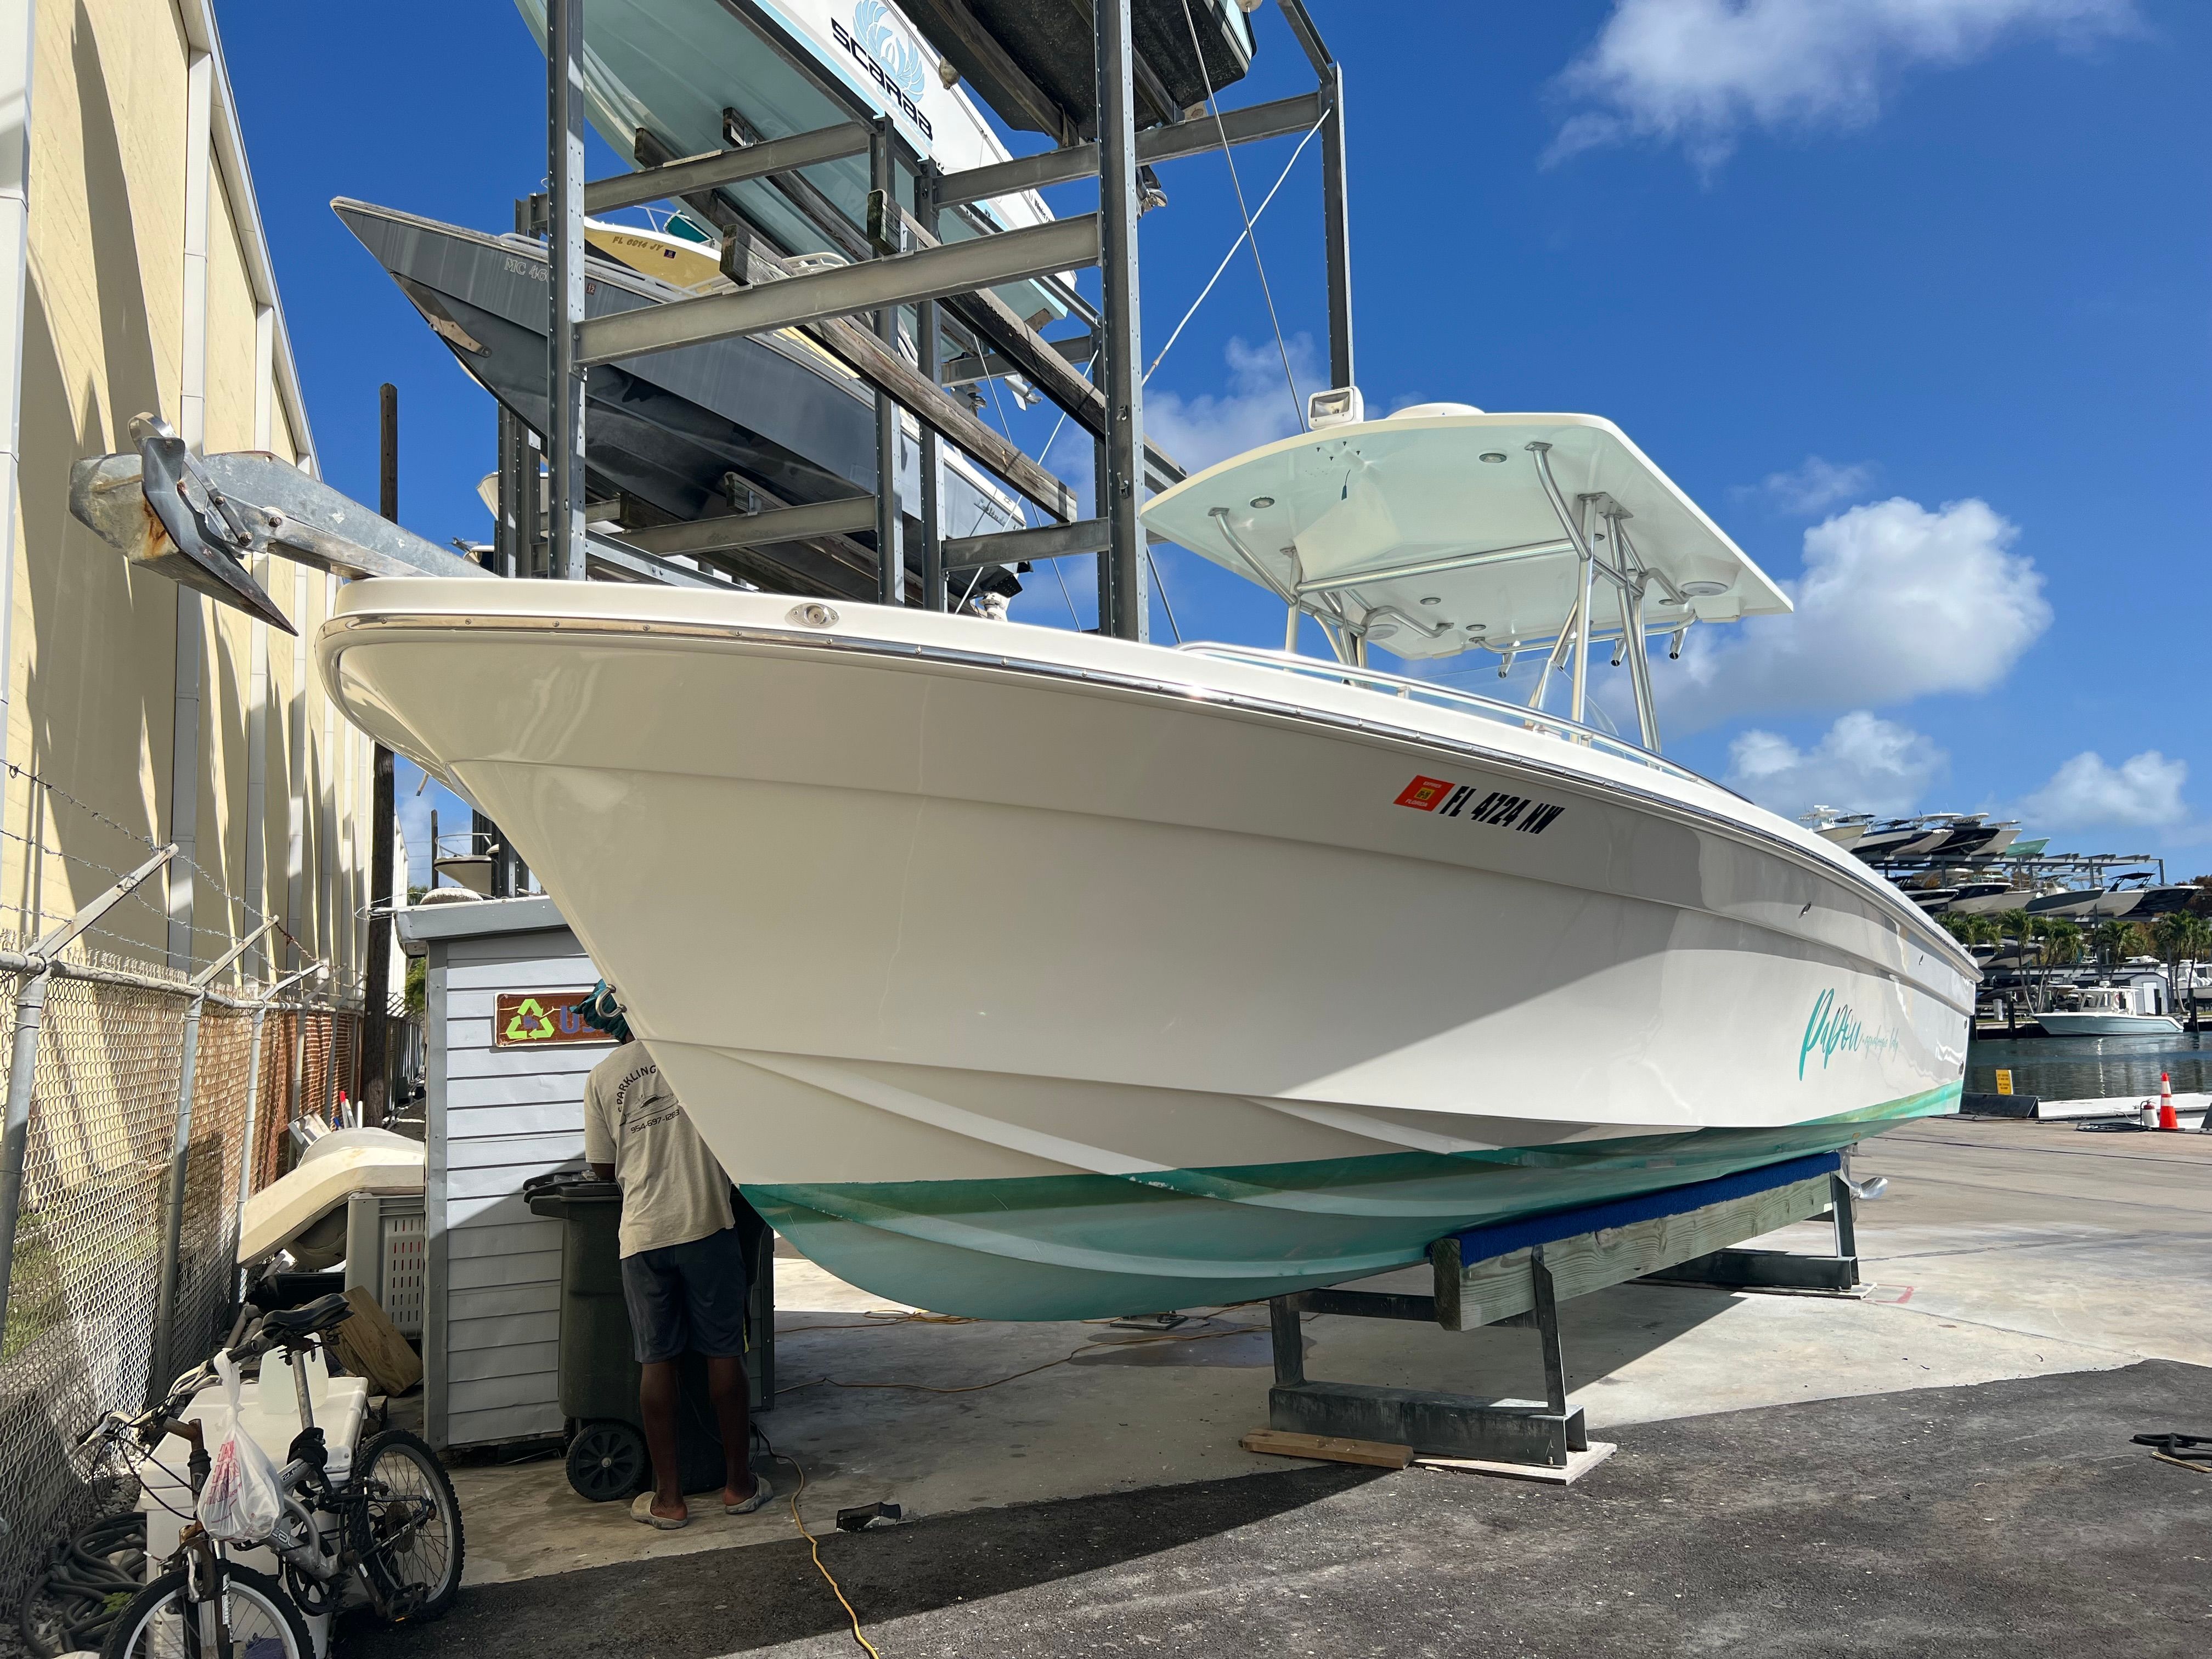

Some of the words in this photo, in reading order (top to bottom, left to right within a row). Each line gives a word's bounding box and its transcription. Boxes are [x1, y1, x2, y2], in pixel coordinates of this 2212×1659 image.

[612, 236, 623, 244] FL
[504, 258, 527, 275] MC
[1438, 786, 1477, 817] FL
[1470, 792, 1532, 827] 4724
[1515, 803, 1566, 834] NW
[630, 1109, 680, 1134] 954-697-1283
